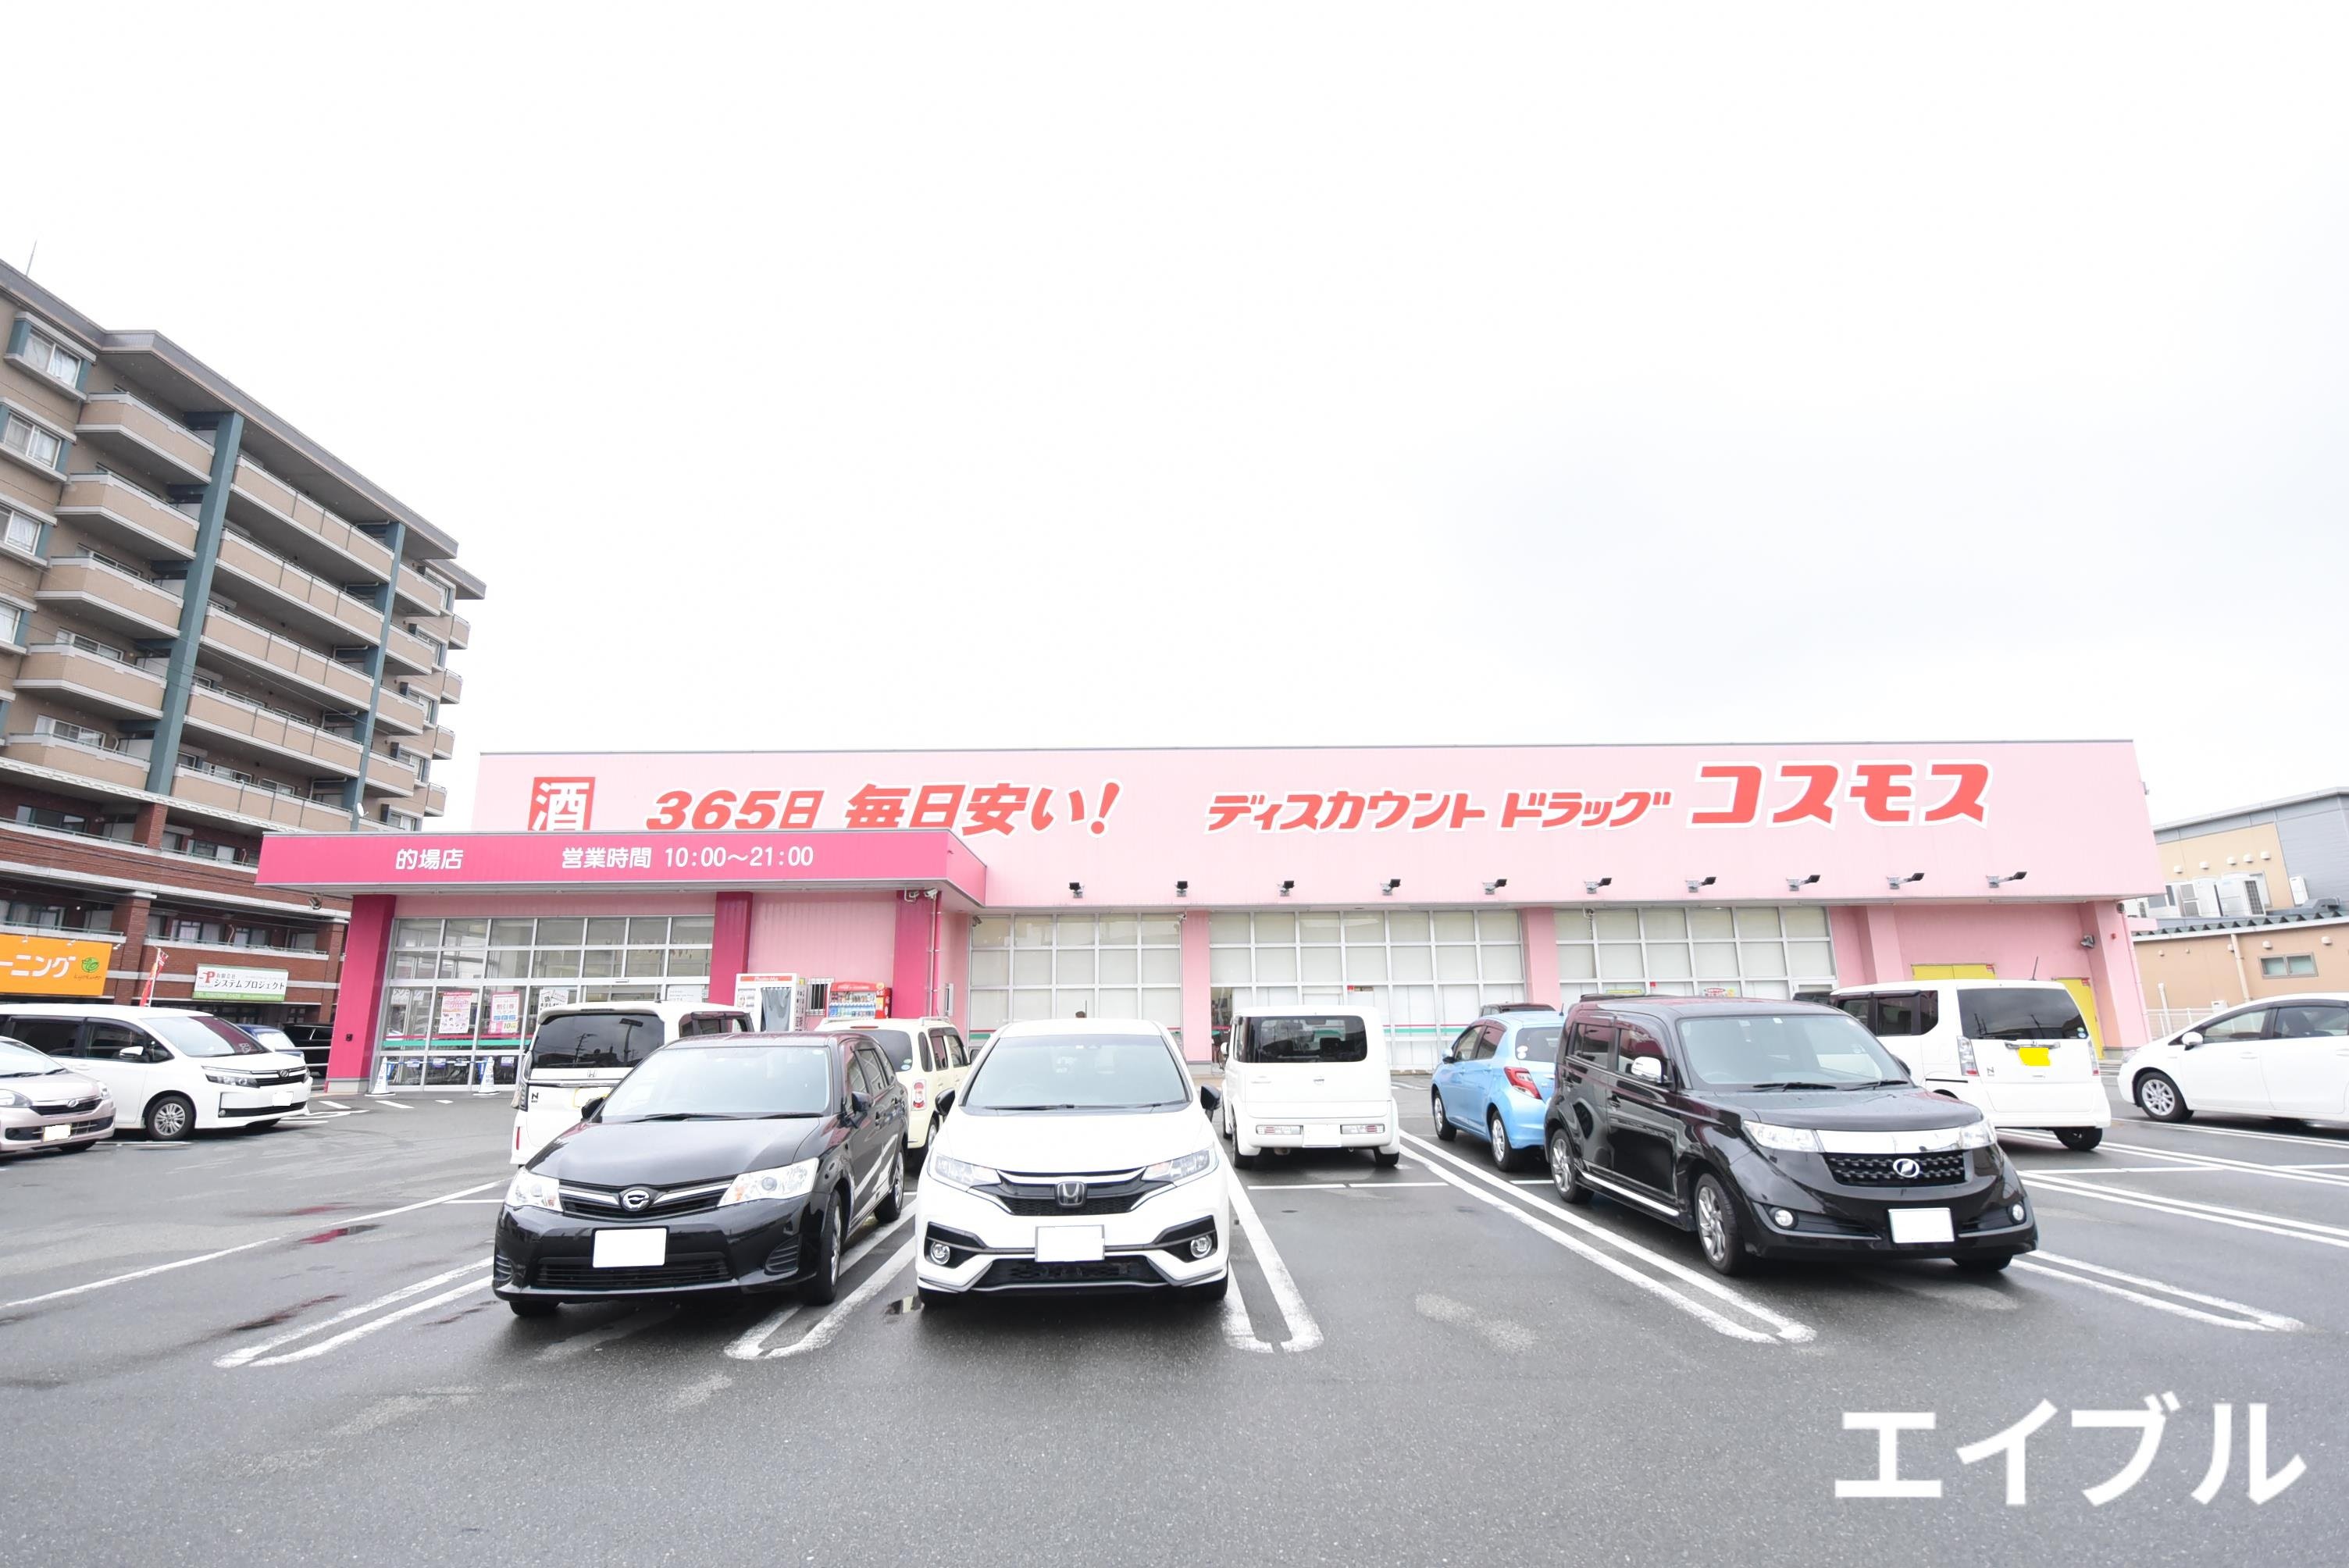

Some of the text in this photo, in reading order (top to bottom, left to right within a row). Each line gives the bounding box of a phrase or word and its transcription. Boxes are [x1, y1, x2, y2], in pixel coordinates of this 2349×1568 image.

[532, 782, 590, 830] 酒
[646, 782, 1121, 836] 365日 毎日安い!
[1208, 764, 1989, 830] ディスカウント ドラッグ コスモス
[395, 848, 464, 871] 的場店
[561, 846, 652, 869] 営業時間
[214, 979, 285, 990] システムプロジェクト
